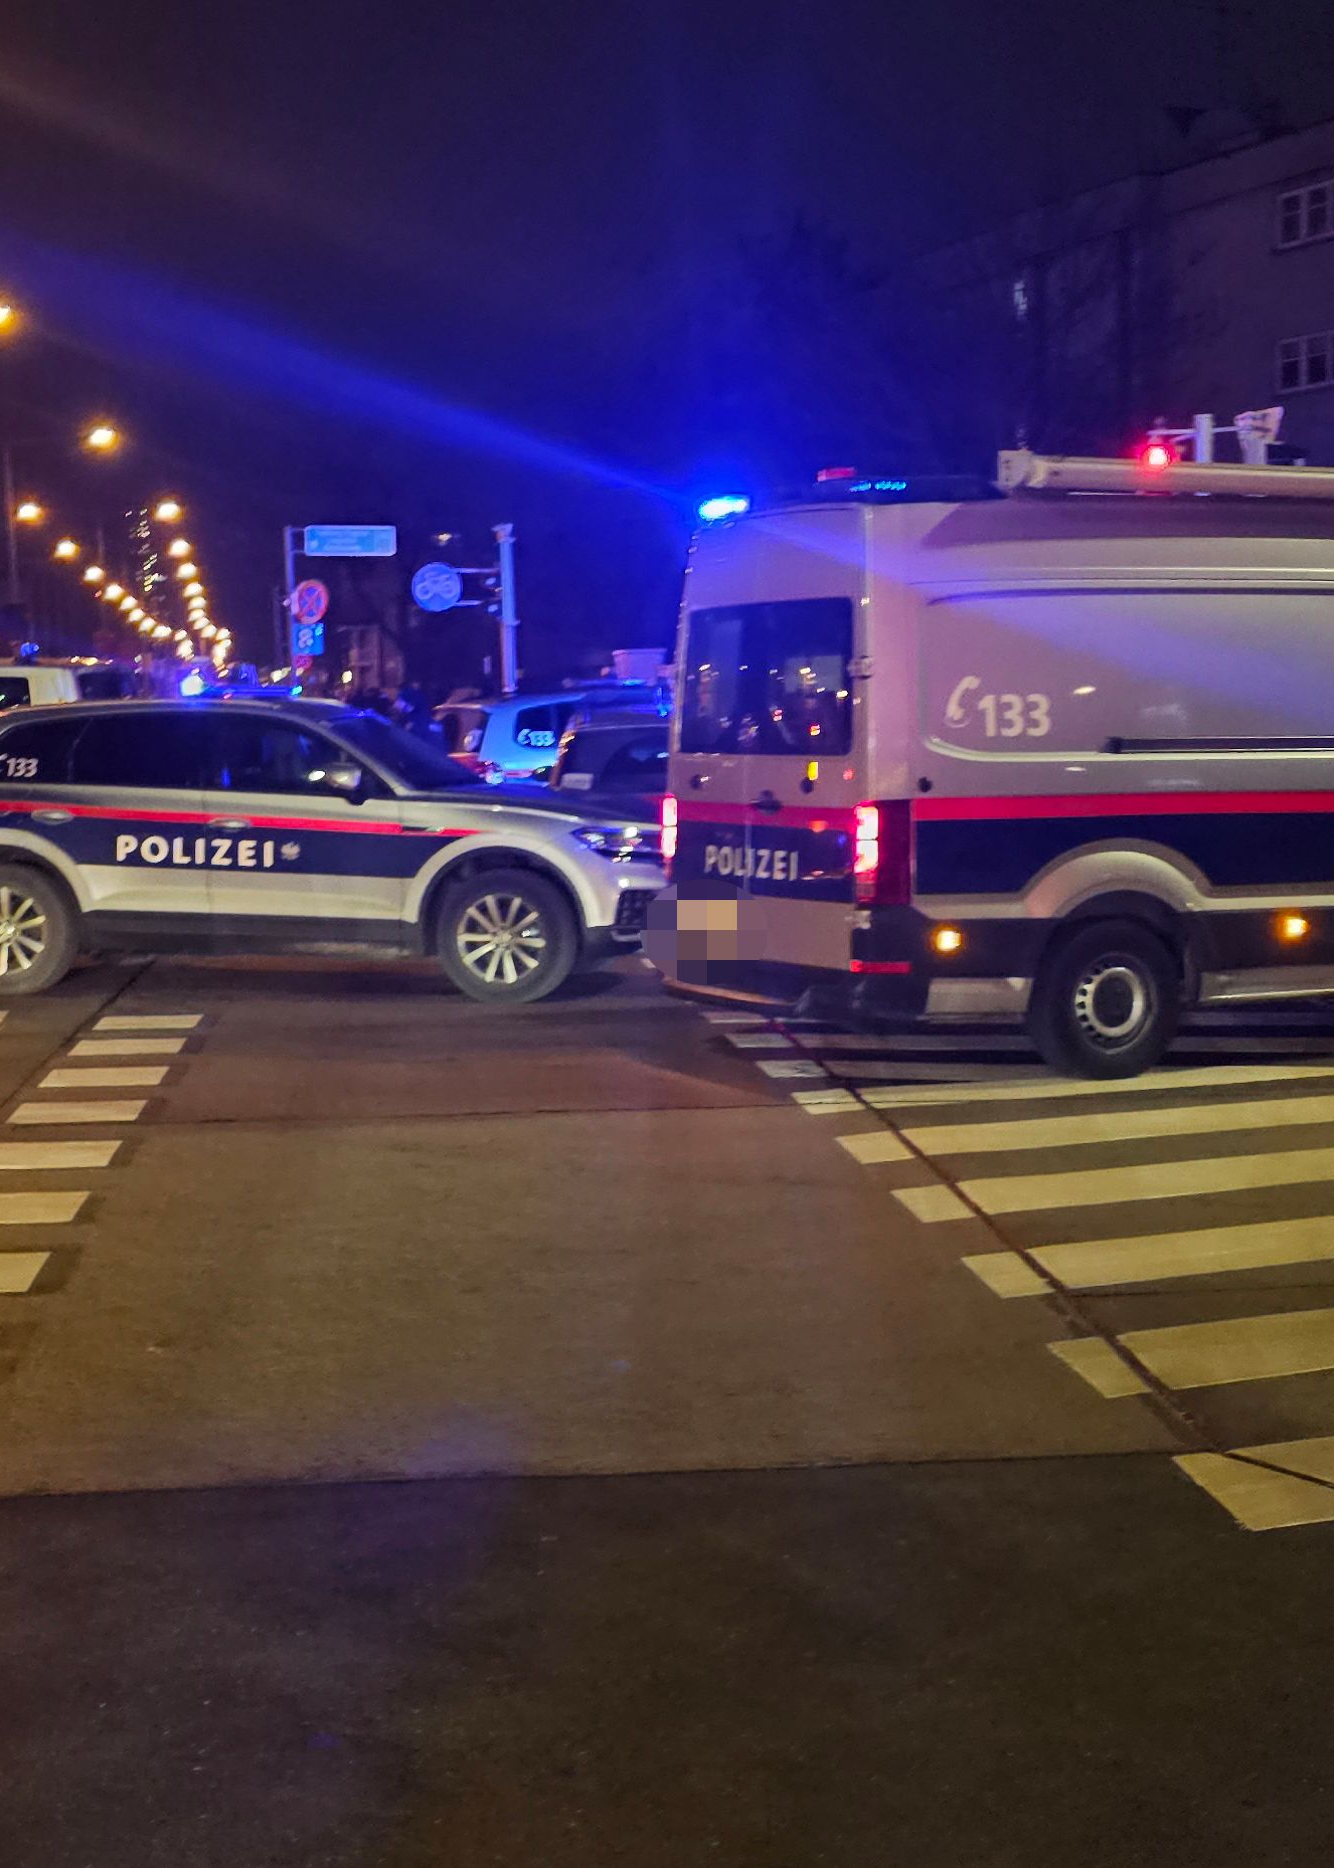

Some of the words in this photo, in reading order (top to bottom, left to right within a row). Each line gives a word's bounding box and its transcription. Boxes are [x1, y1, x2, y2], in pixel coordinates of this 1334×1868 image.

[977, 693, 1052, 737] 133
[6, 757, 39, 778] 133
[116, 834, 274, 867] POLIZEI
[704, 844, 799, 882] POLIZEI
